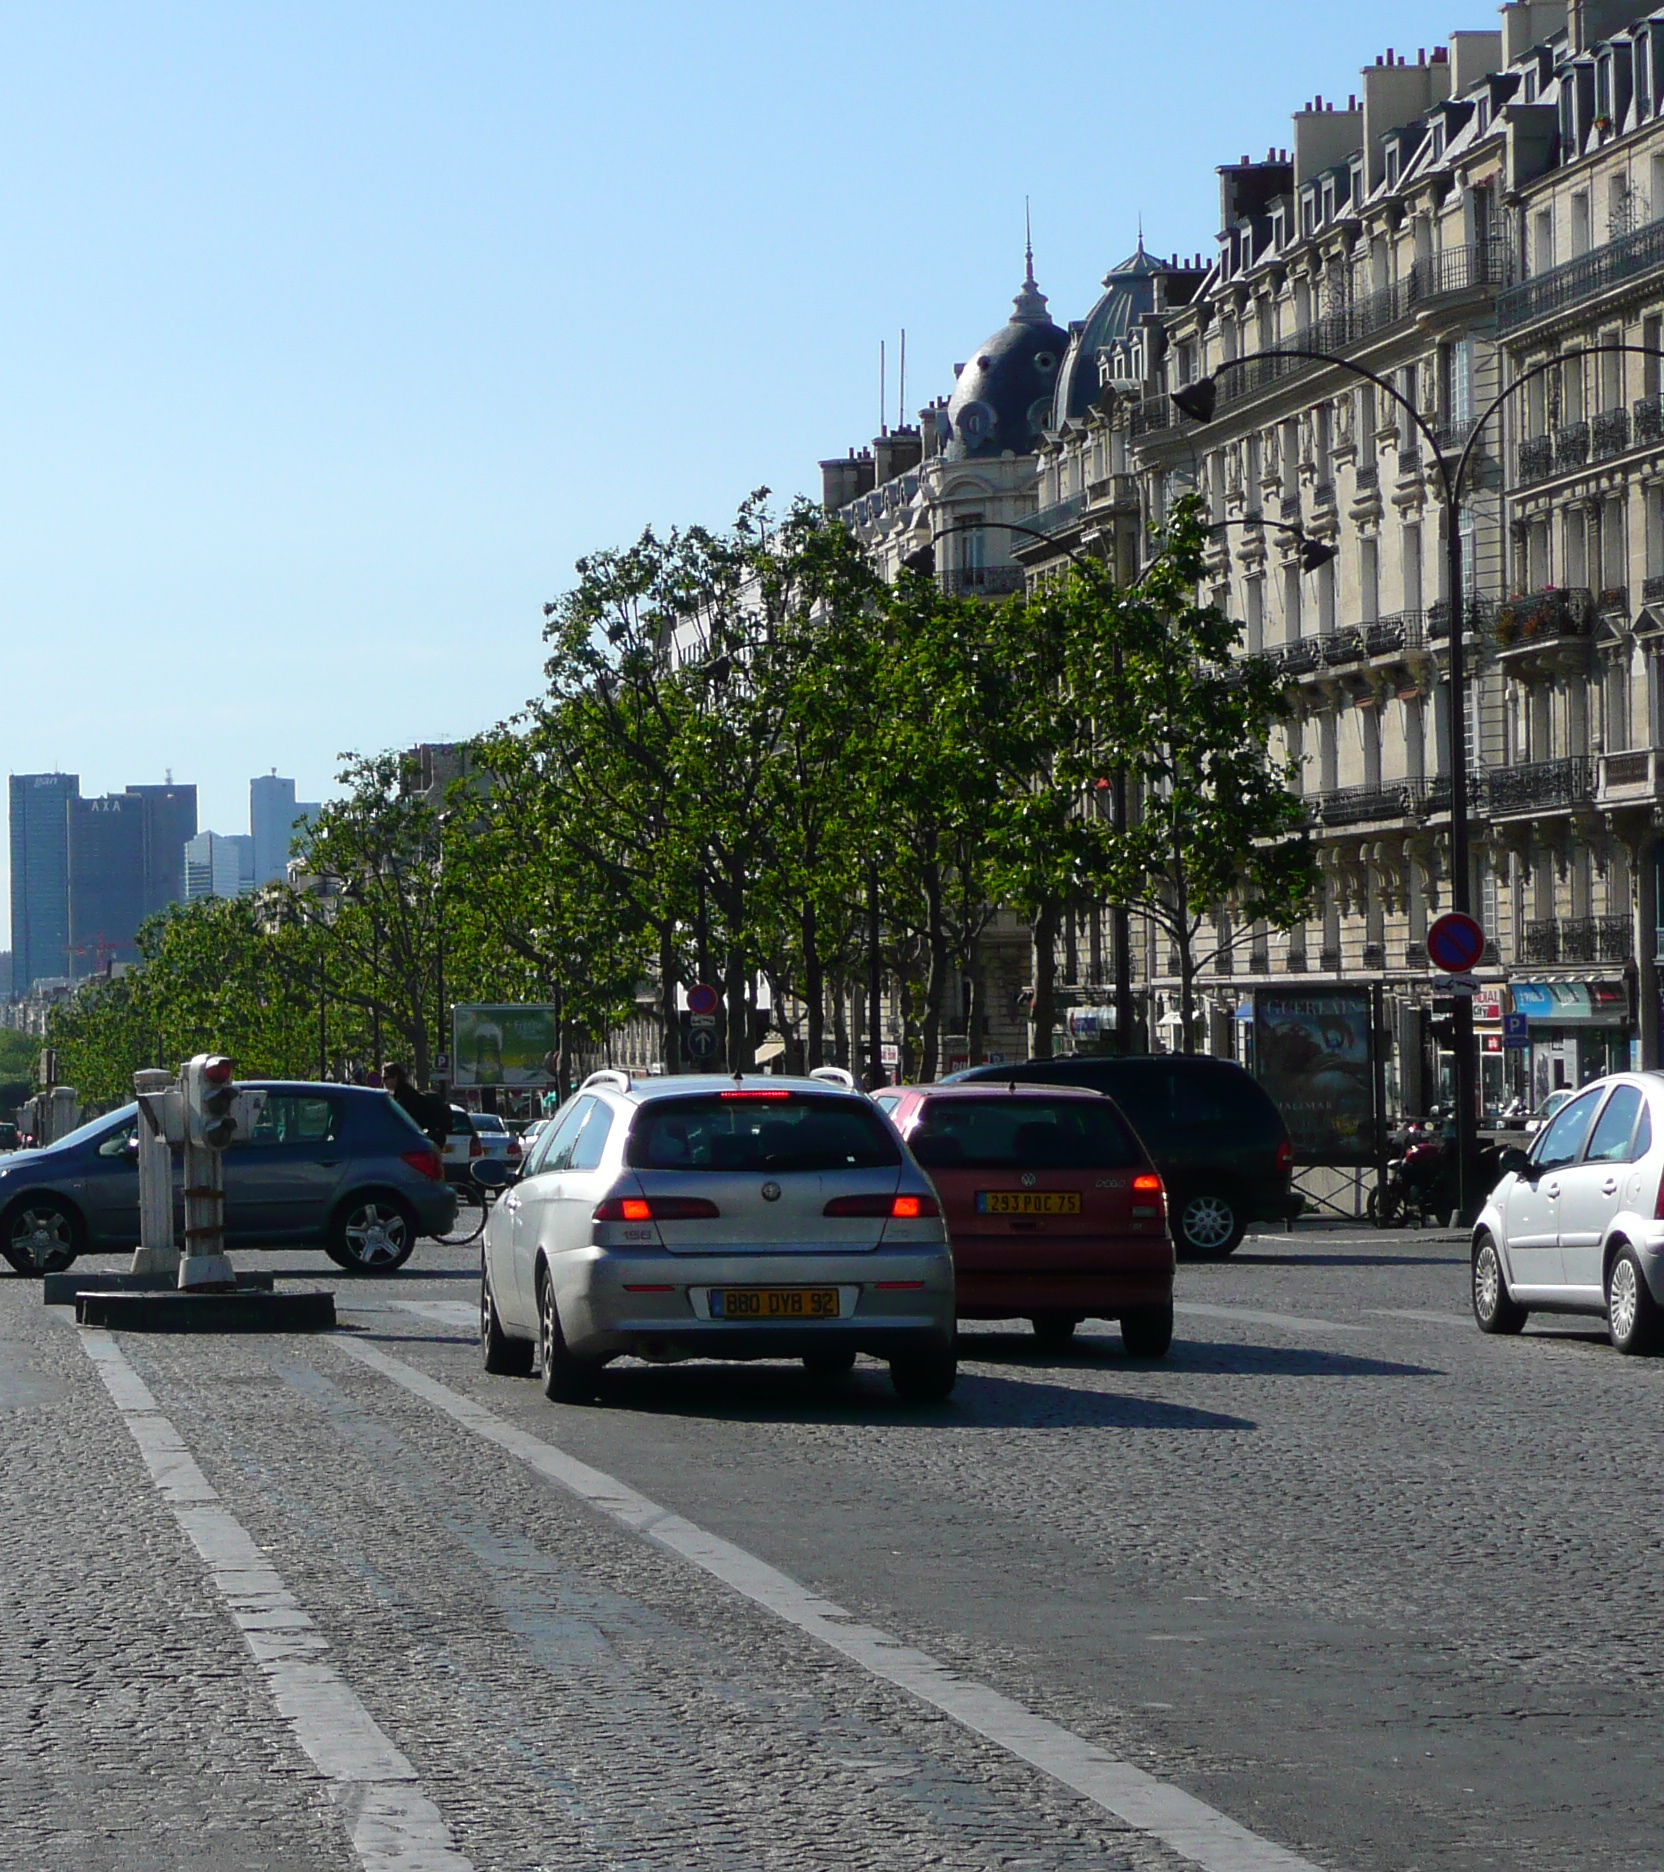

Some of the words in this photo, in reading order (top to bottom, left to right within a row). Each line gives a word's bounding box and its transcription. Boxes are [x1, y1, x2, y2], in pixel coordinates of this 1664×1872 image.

[33, 776, 58, 788] gan
[91, 800, 121, 811] AXA
[1266, 999, 1365, 1015] GUERLAIN
[1510, 1018, 1521, 1032] P
[438, 1056, 446, 1067] P
[991, 1195, 1019, 1211] 293
[1057, 1195, 1076, 1211] 75
[726, 1293, 760, 1313] 880
[768, 1293, 803, 1313] DYB
[811, 1293, 834, 1313] 92
